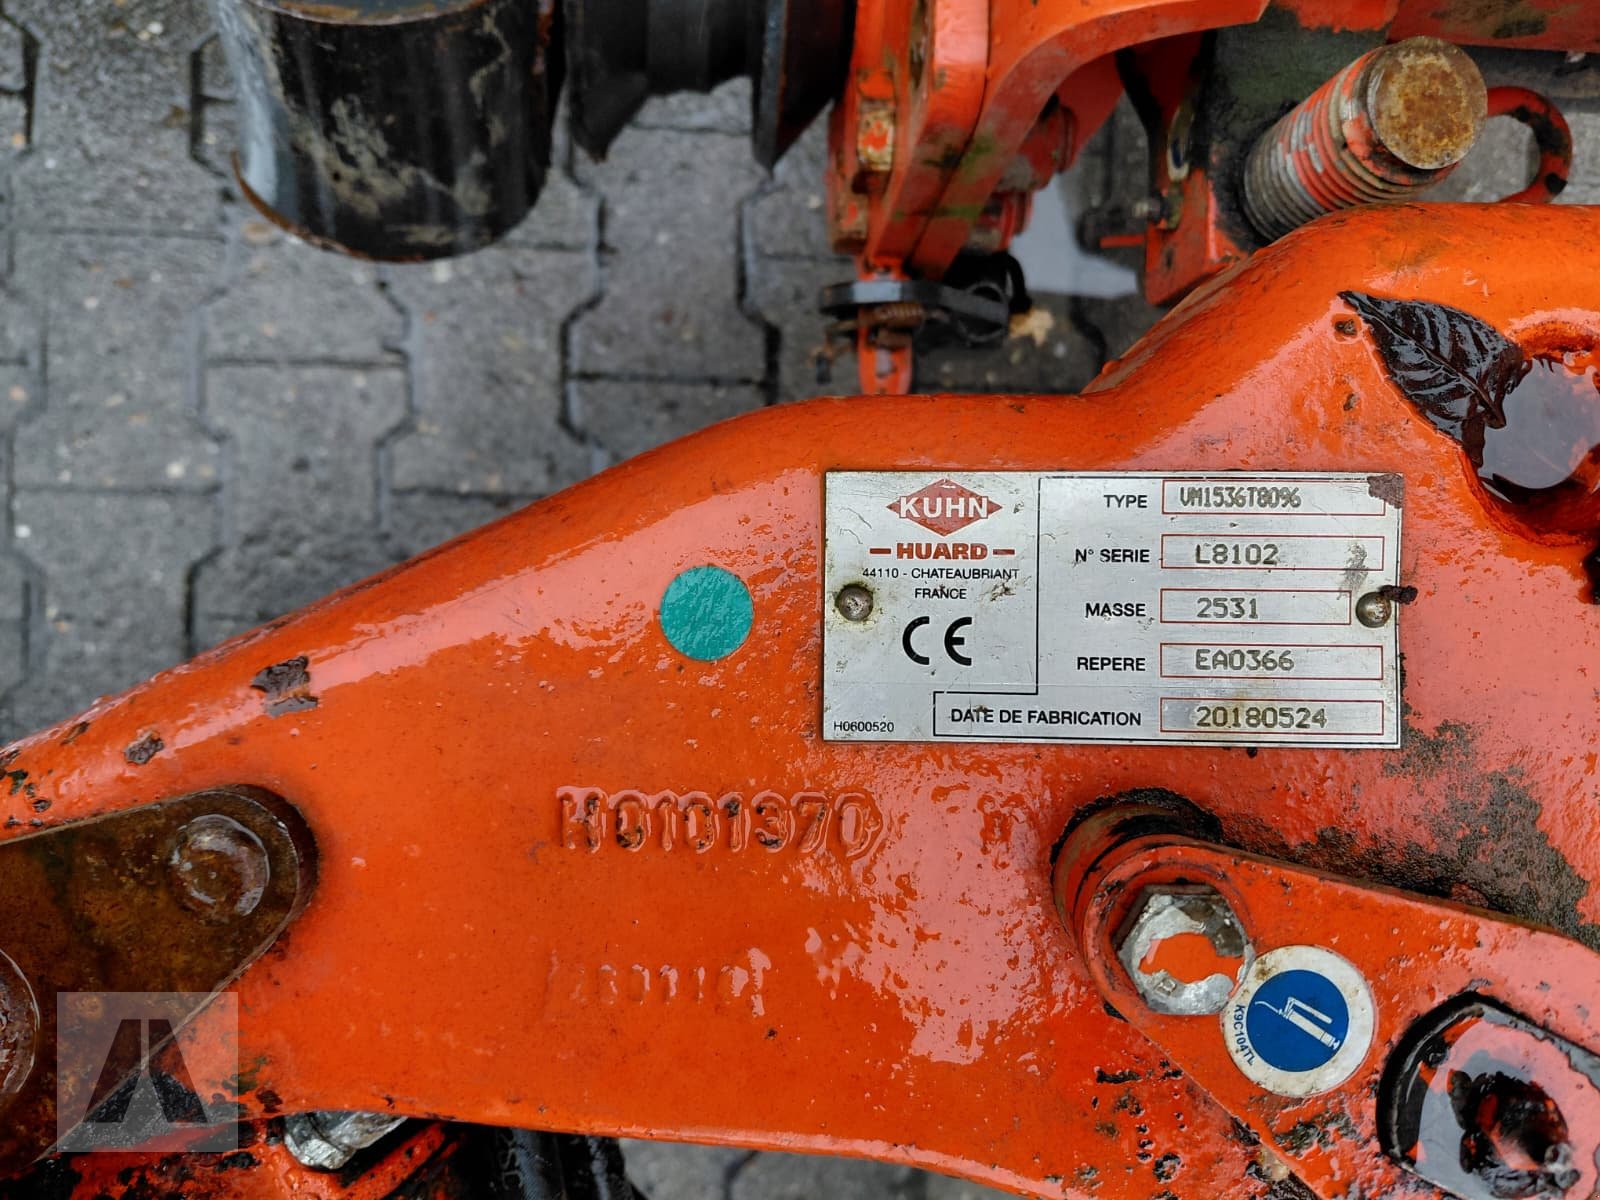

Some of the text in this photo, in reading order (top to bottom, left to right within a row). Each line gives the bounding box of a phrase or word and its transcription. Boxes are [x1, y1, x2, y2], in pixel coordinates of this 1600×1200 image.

[900, 496, 988, 519] KUHN
[1103, 486, 1302, 509] TYPE VM1536T8096
[896, 542, 988, 560] HUARD
[1099, 548, 1150, 563] SERIE
[1195, 543, 1279, 566] L8102
[862, 568, 899, 579] 44110
[911, 567, 1020, 580] CHATEAUBRIANT
[914, 588, 967, 600] FRANCE
[1085, 597, 1259, 619] MASSE 2531
[1077, 649, 1295, 672] REPERE EA0366
[833, 721, 895, 733] H0600520
[950, 706, 1328, 729] DATE DE FABRICATION 20180524
[1233, 1004, 1256, 1066] K9C104TL
